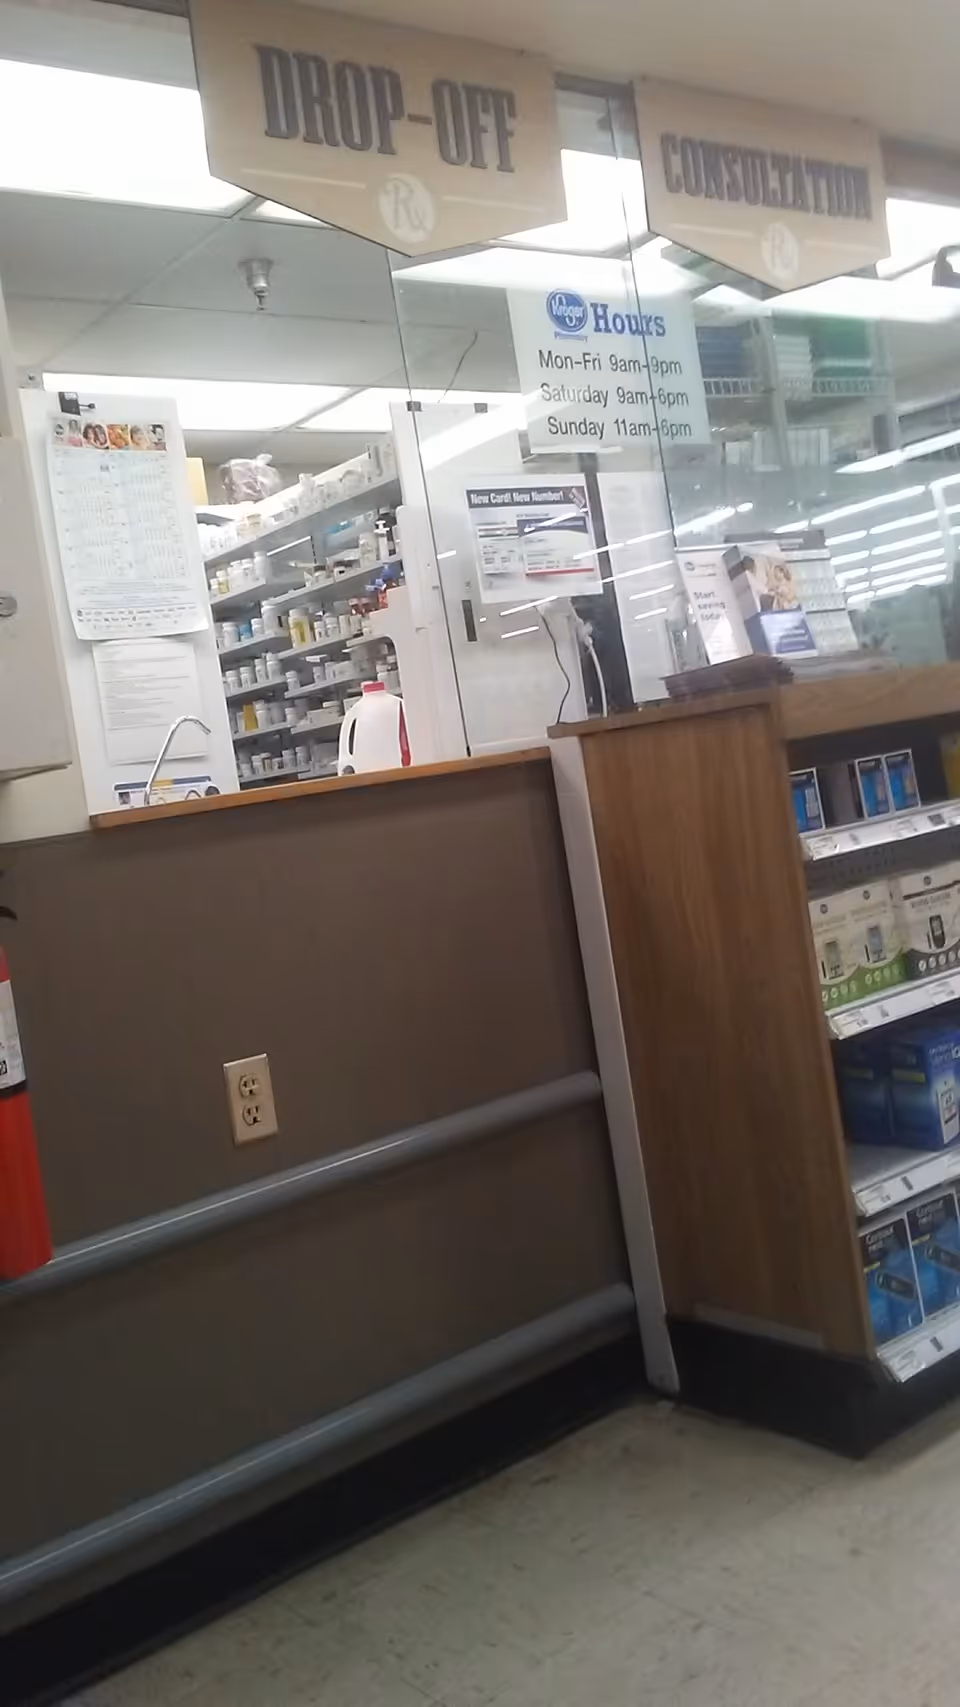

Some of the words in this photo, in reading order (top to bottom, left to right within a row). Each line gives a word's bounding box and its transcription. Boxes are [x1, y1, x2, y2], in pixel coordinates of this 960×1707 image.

[253, 44, 516, 173] DROP-OFF
[660, 132, 873, 221] CONSULTATION
[551, 293, 585, 327] Kroger
[590, 302, 666, 337] Hours
[538, 350, 602, 371] Mon-Fri
[609, 353, 682, 377] 9am-9pm
[540, 382, 609, 408] Saturday
[616, 386, 689, 409] 9am-6pm
[547, 416, 605, 440] Sunday
[614, 418, 692, 440] 11am-6pm
[470, 493, 489, 504] New
[490, 492, 512, 503] Card!
[513, 491, 530, 502] New
[531, 490, 564, 501] Number!
[694, 591, 716, 599] Start
